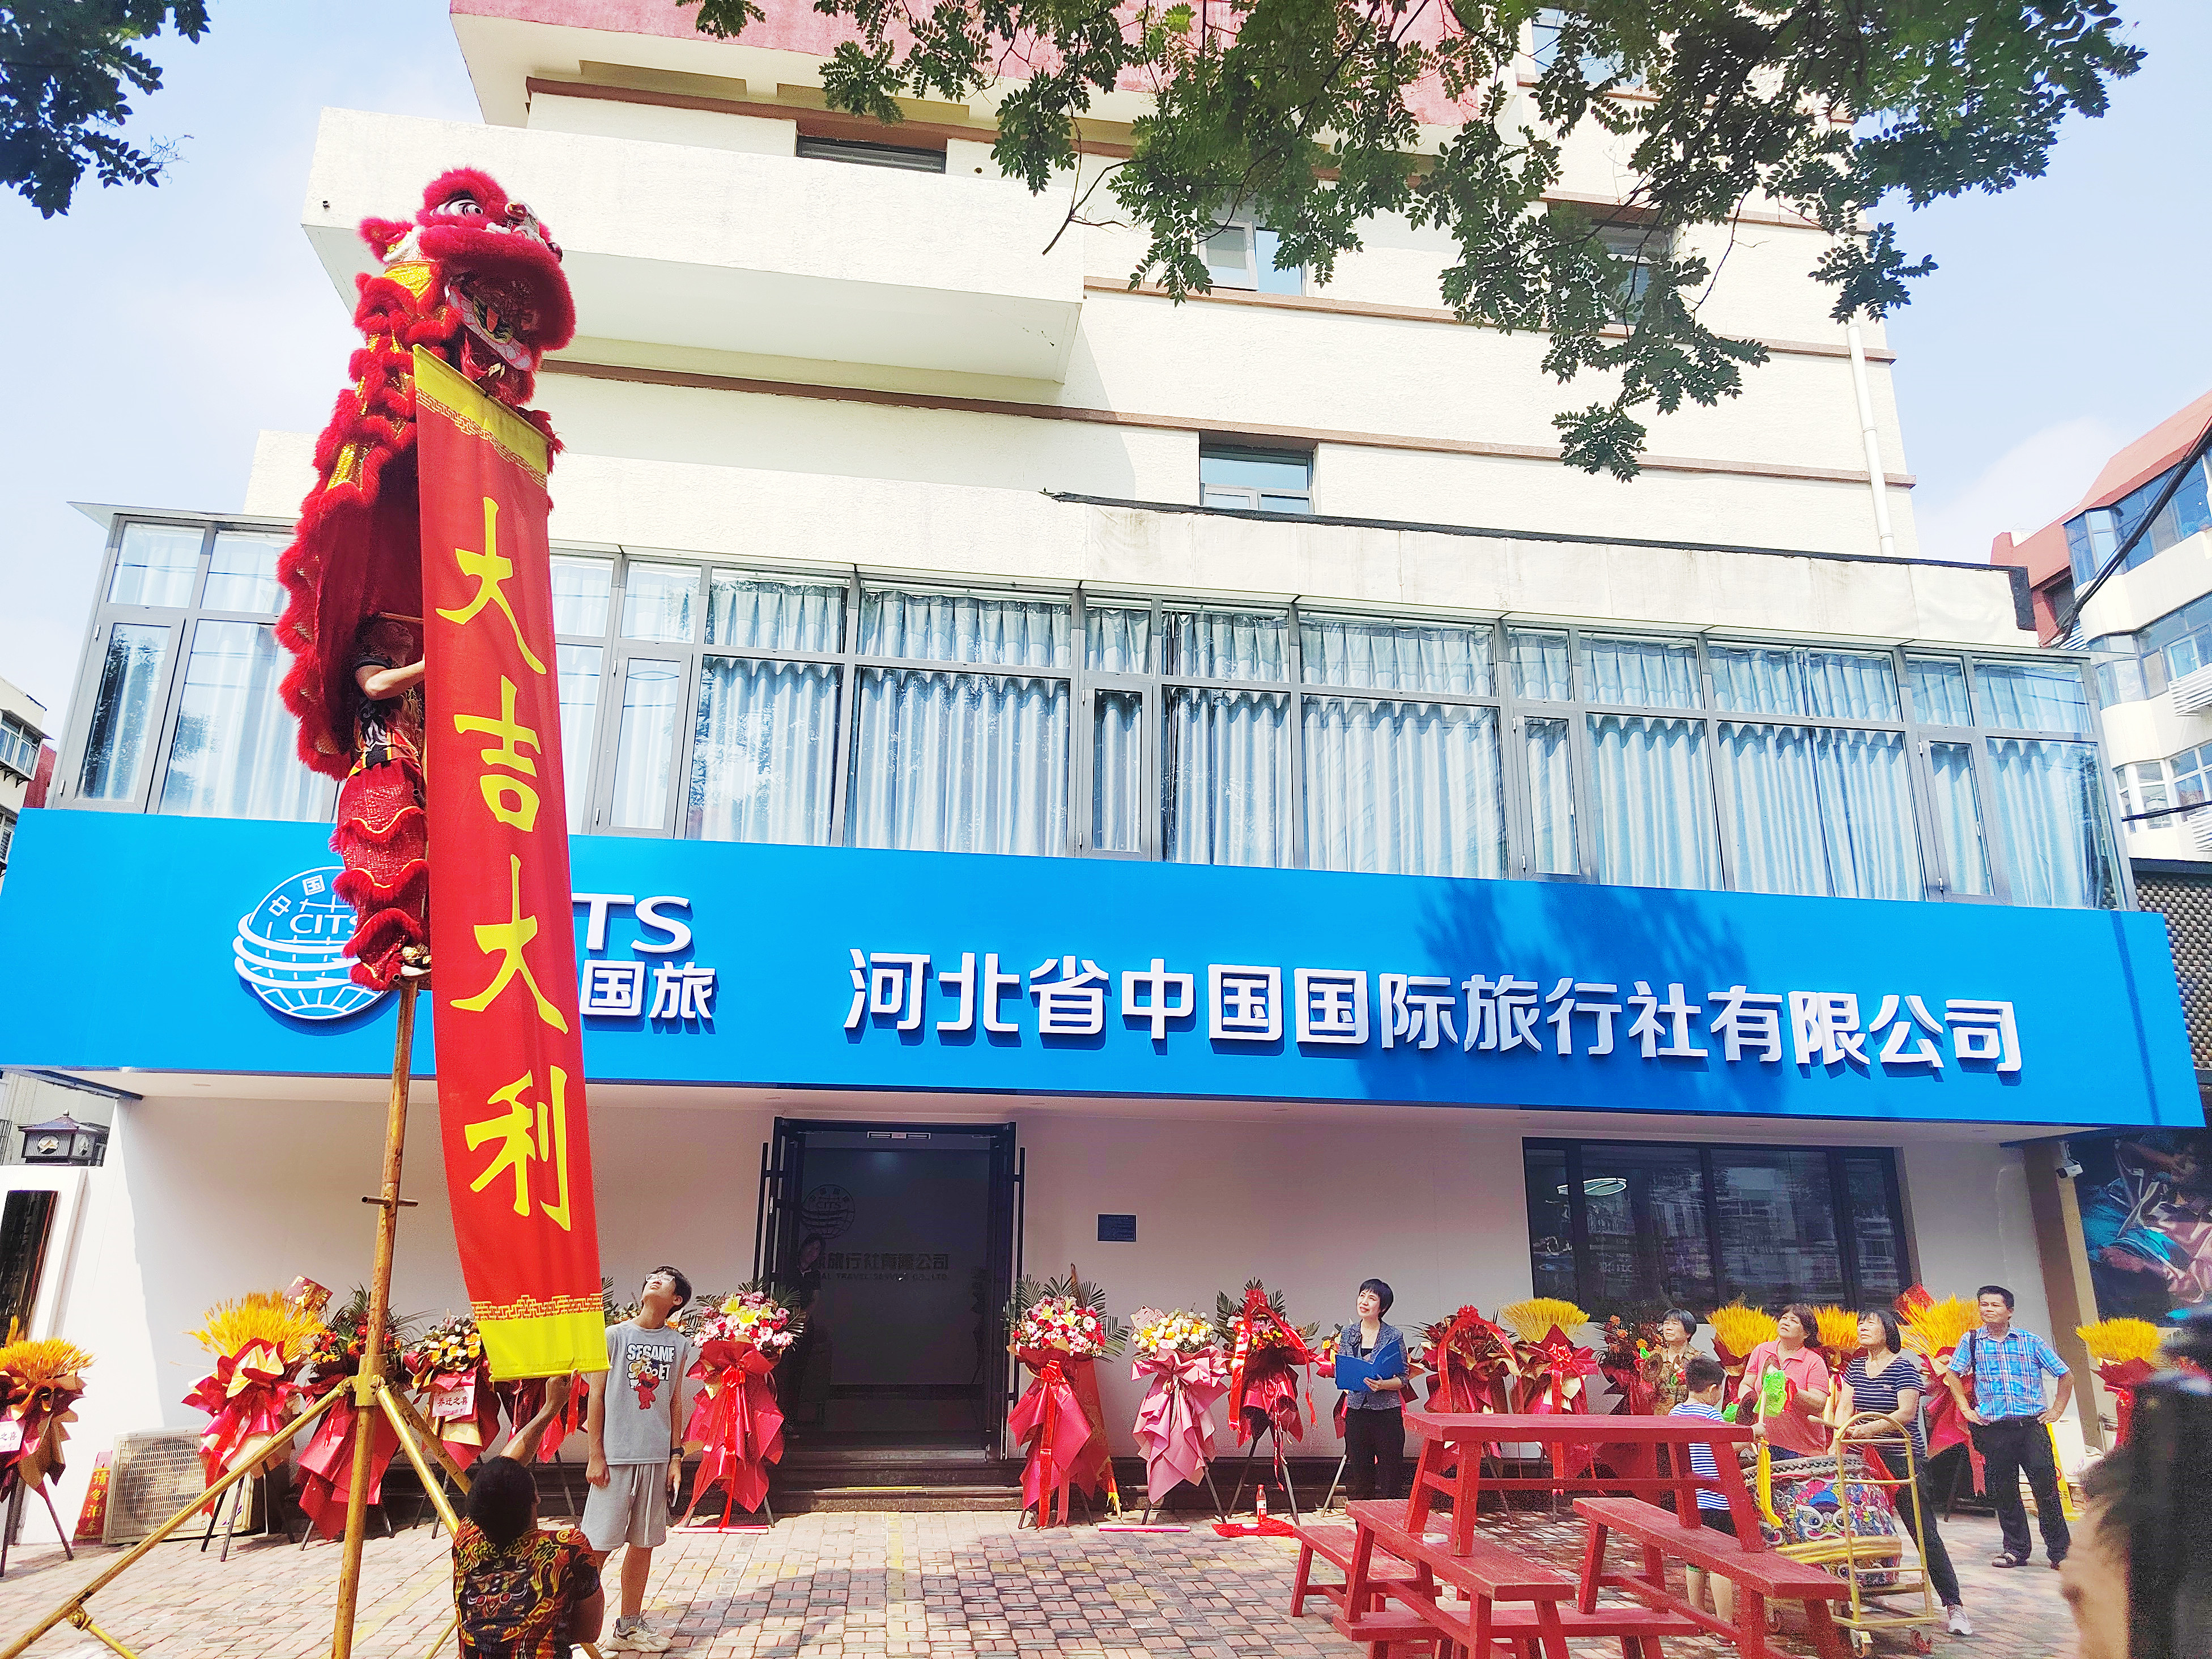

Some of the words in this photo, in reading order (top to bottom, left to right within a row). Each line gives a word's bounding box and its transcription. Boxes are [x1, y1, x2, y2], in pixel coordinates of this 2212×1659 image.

[435, 496, 571, 1231] 大吉大利
[844, 948, 2023, 1073] 河北省中国国际旅行社有限公司
[627, 1343, 675, 1363] SESAME
